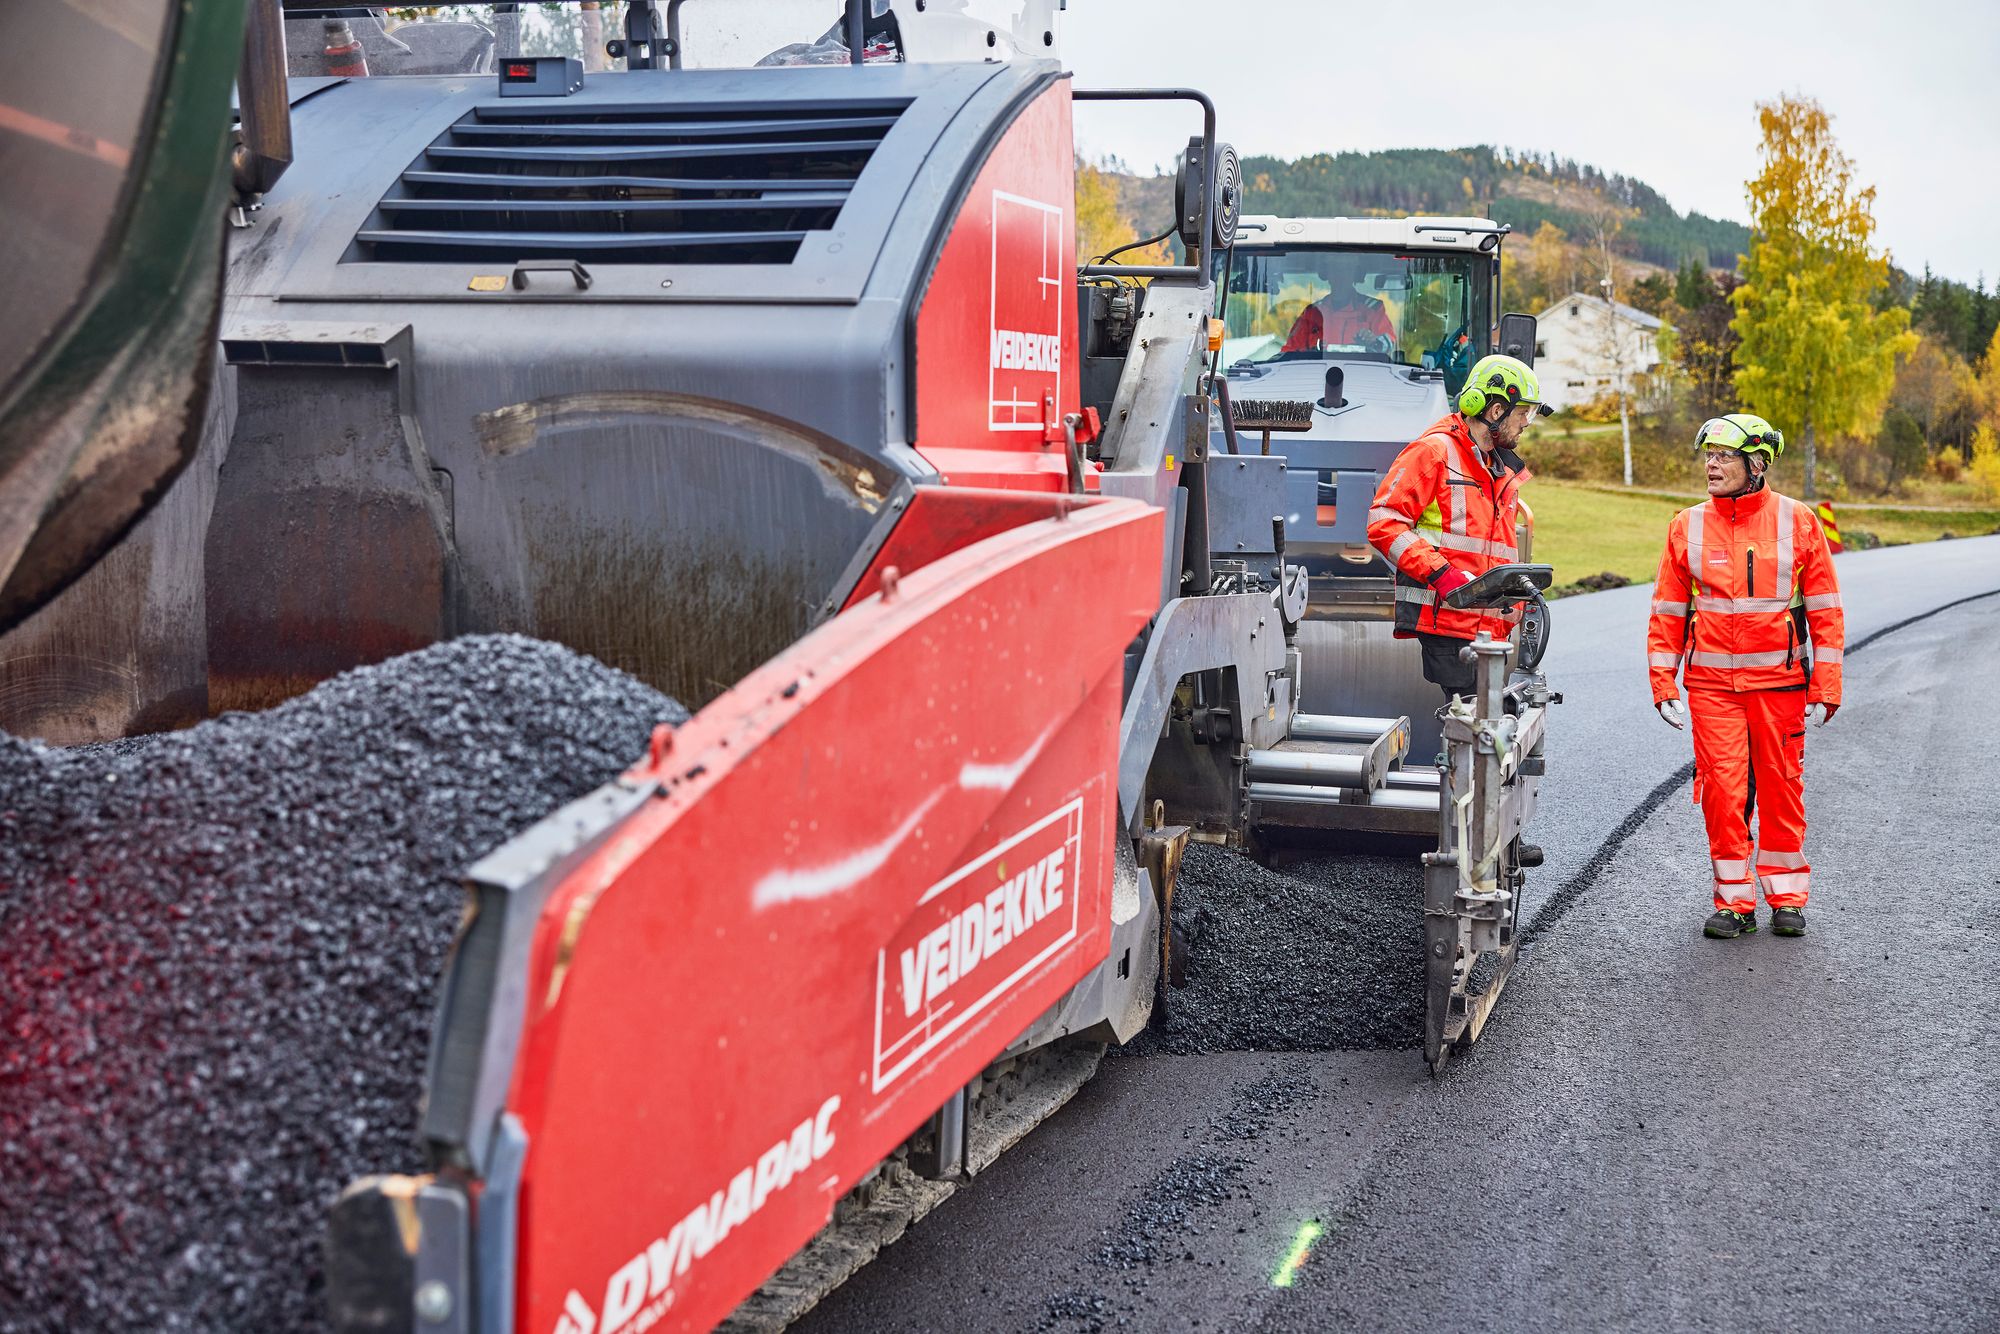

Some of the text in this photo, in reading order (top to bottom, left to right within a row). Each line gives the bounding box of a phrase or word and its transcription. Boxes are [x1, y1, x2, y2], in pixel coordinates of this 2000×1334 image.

[992, 329, 1059, 372] VEIDEKKE
[900, 846, 1065, 1018] VEIDEKKE
[600, 1095, 841, 1334] DYNAPAC
